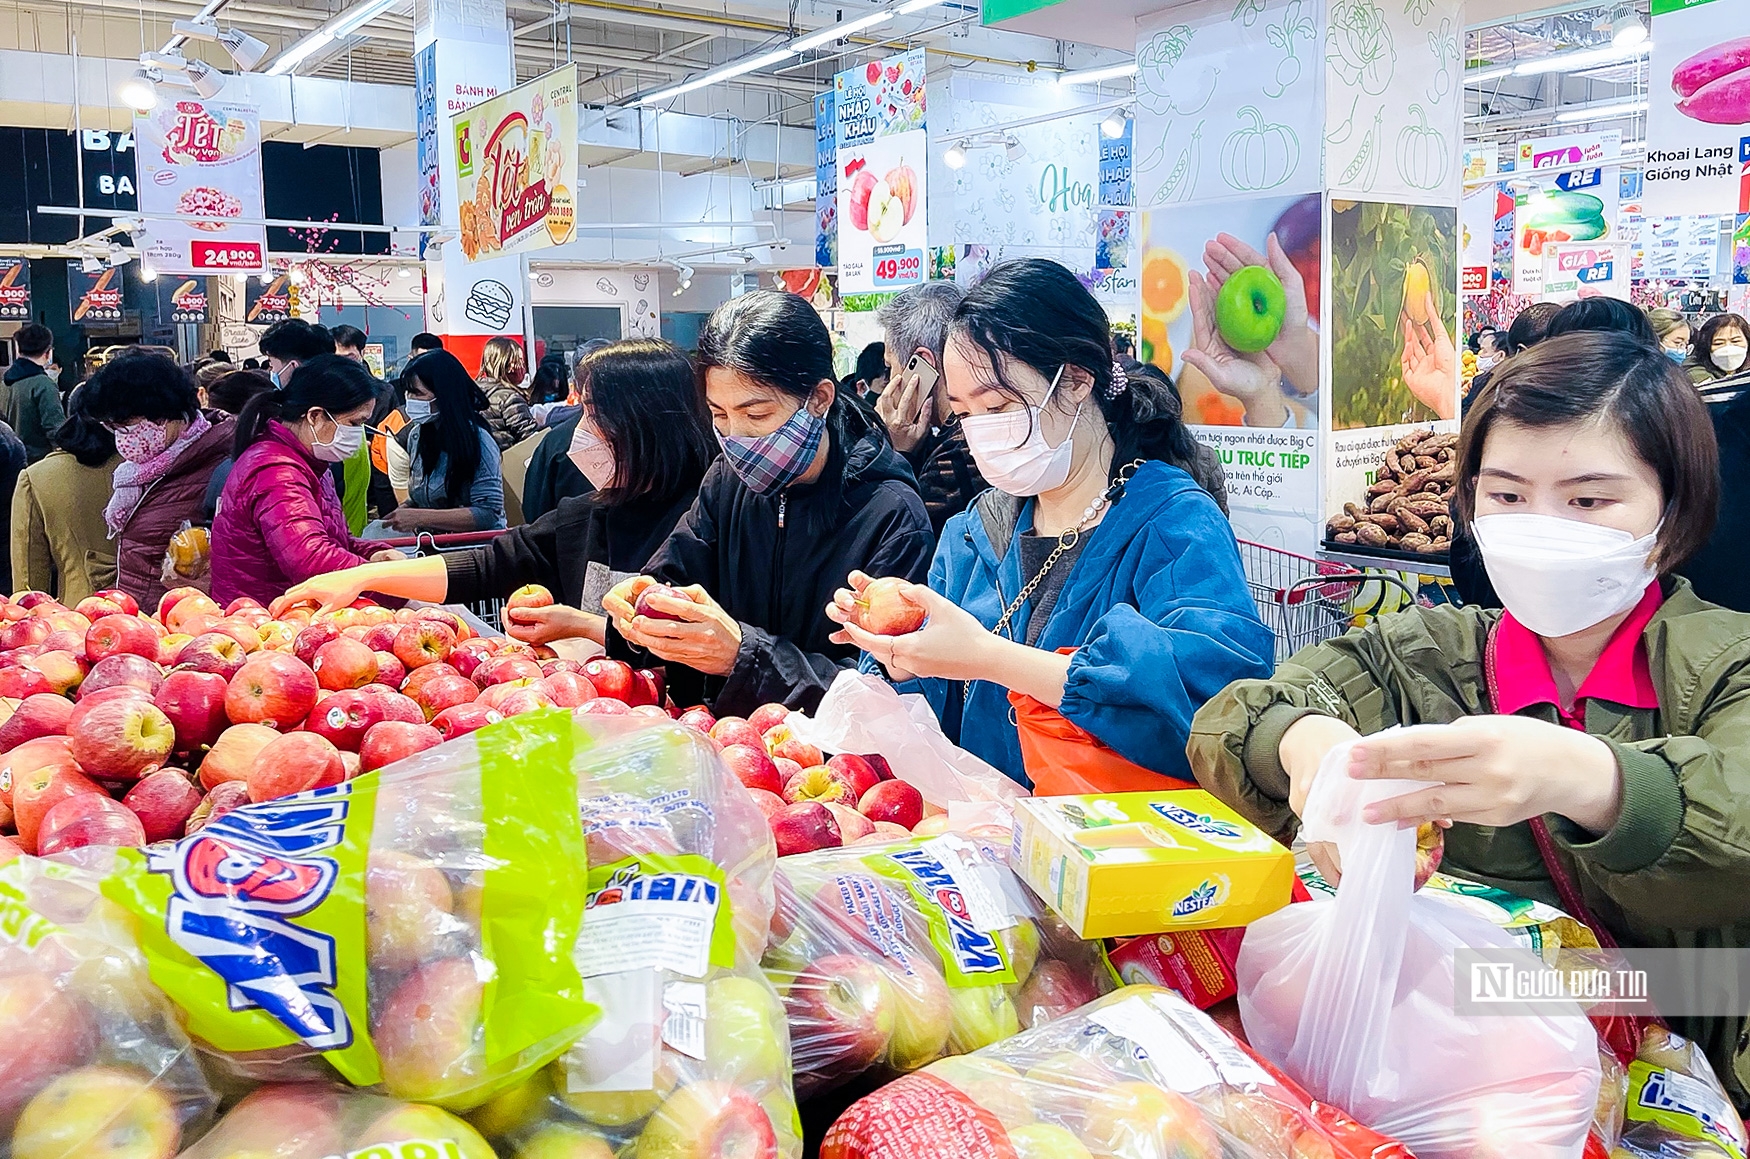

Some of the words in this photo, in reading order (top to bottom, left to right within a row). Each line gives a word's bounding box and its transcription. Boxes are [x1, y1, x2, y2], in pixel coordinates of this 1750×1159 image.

[456, 83, 484, 97] BÁNH
[550, 84, 572, 100] CENTRAL
[553, 96, 570, 108] RETAIL
[839, 98, 870, 122] NHẬP
[845, 115, 876, 139] KHẨU
[1111, 145, 1129, 162] HỘI
[1647, 147, 1690, 163] Khoai
[1695, 146, 1733, 159] Lang
[1099, 166, 1131, 186] NHẬP
[1645, 166, 1690, 181] Giống
[1695, 163, 1733, 178] Nhật
[100, 174, 135, 195] BA
[1040, 163, 1094, 212] Hoa
[525, 189, 546, 221] tròn
[1562, 250, 1590, 266] GIÁ
[1225, 434, 1246, 446] ngon
[1248, 433, 1266, 444] nhất
[1267, 434, 1288, 447] được
[1290, 435, 1304, 450] Big
[1306, 435, 1315, 448] C
[1236, 450, 1275, 470] TRỰC
[1279, 446, 1311, 469] TIẾP
[1370, 453, 1380, 466] Big
[1236, 470, 1250, 481] trên
[1252, 470, 1265, 482] thế
[1267, 472, 1283, 485] giới
[1242, 485, 1253, 495] Ai
[1175, 896, 1216, 914] NESTEA
[956, 1122, 977, 1146] We
